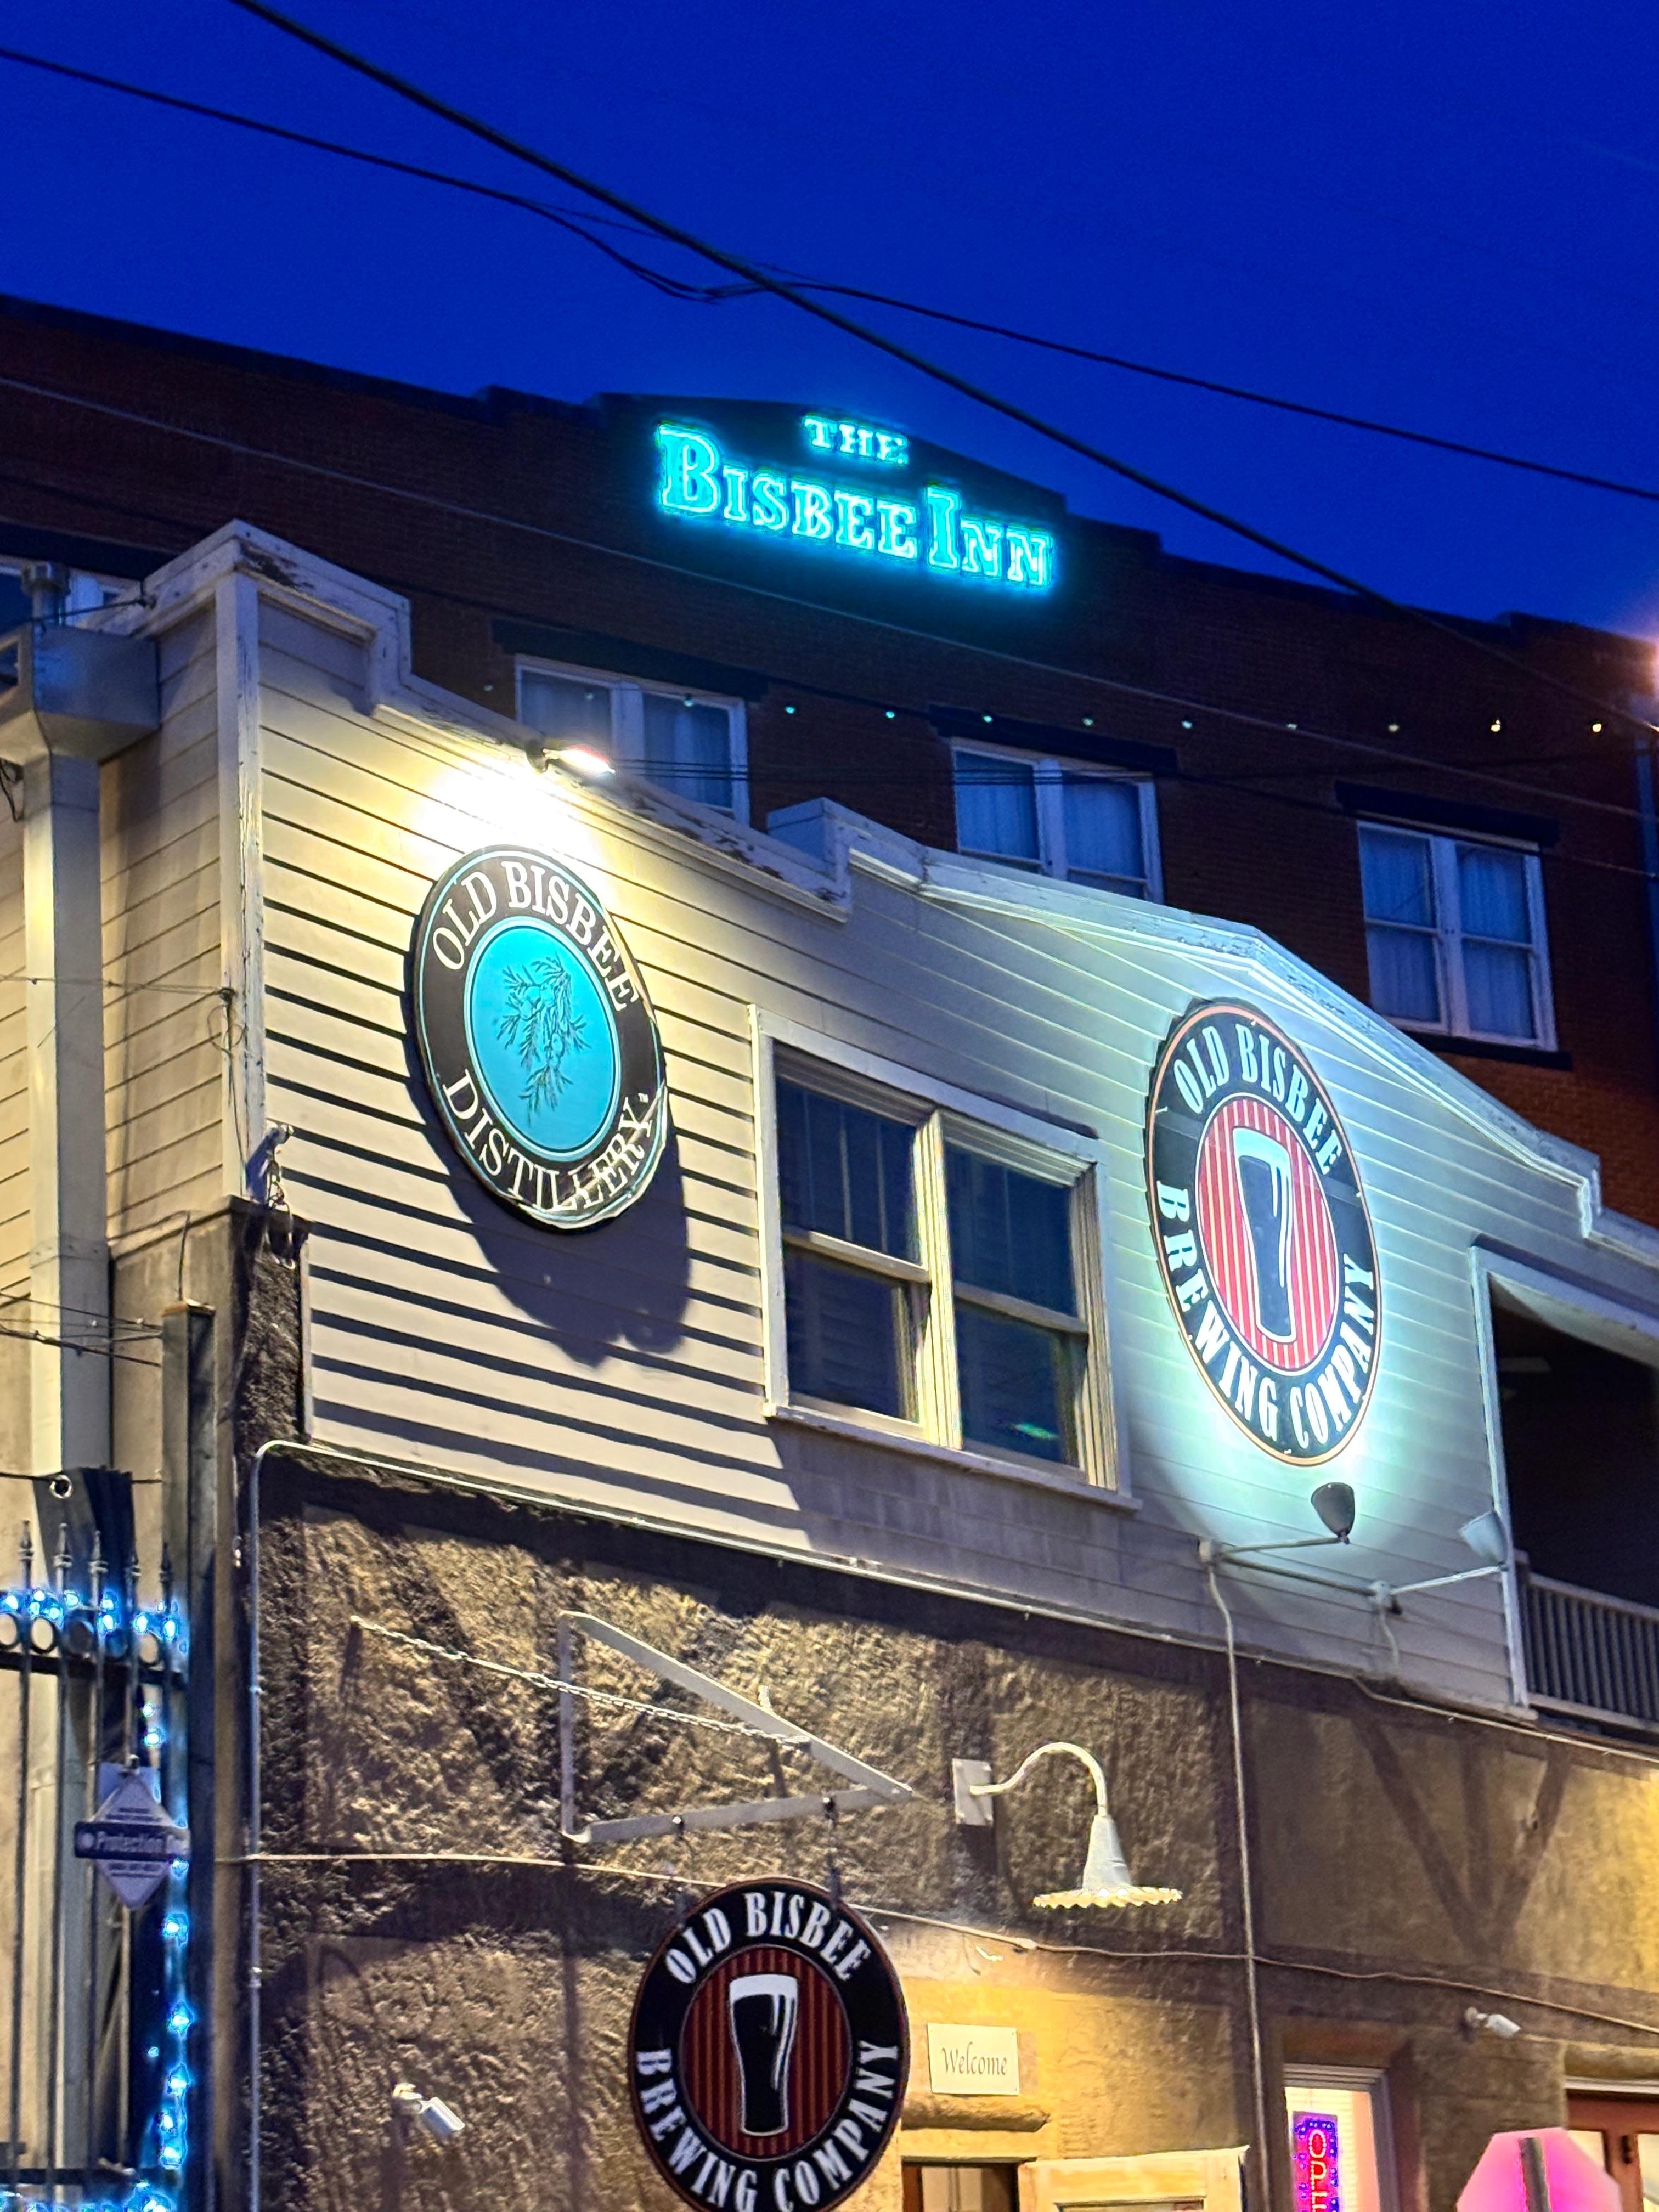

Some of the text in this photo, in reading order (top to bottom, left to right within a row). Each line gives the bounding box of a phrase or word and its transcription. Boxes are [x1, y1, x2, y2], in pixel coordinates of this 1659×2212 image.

[658, 424, 1053, 588] BISBEE INN
[803, 413, 908, 465] THE
[432, 861, 640, 1012] OLD BISBEE
[442, 1069, 652, 1209] DISTILLERY
[1174, 1023, 1342, 1175] OLD BISBEE
[1156, 1181, 1375, 1450] BREWING COMPANY
[664, 1891, 871, 1984] OLD BISBEE
[636, 2040, 899, 2212] BREWING COMPANY
[940, 2041, 1008, 2077] Welcome
